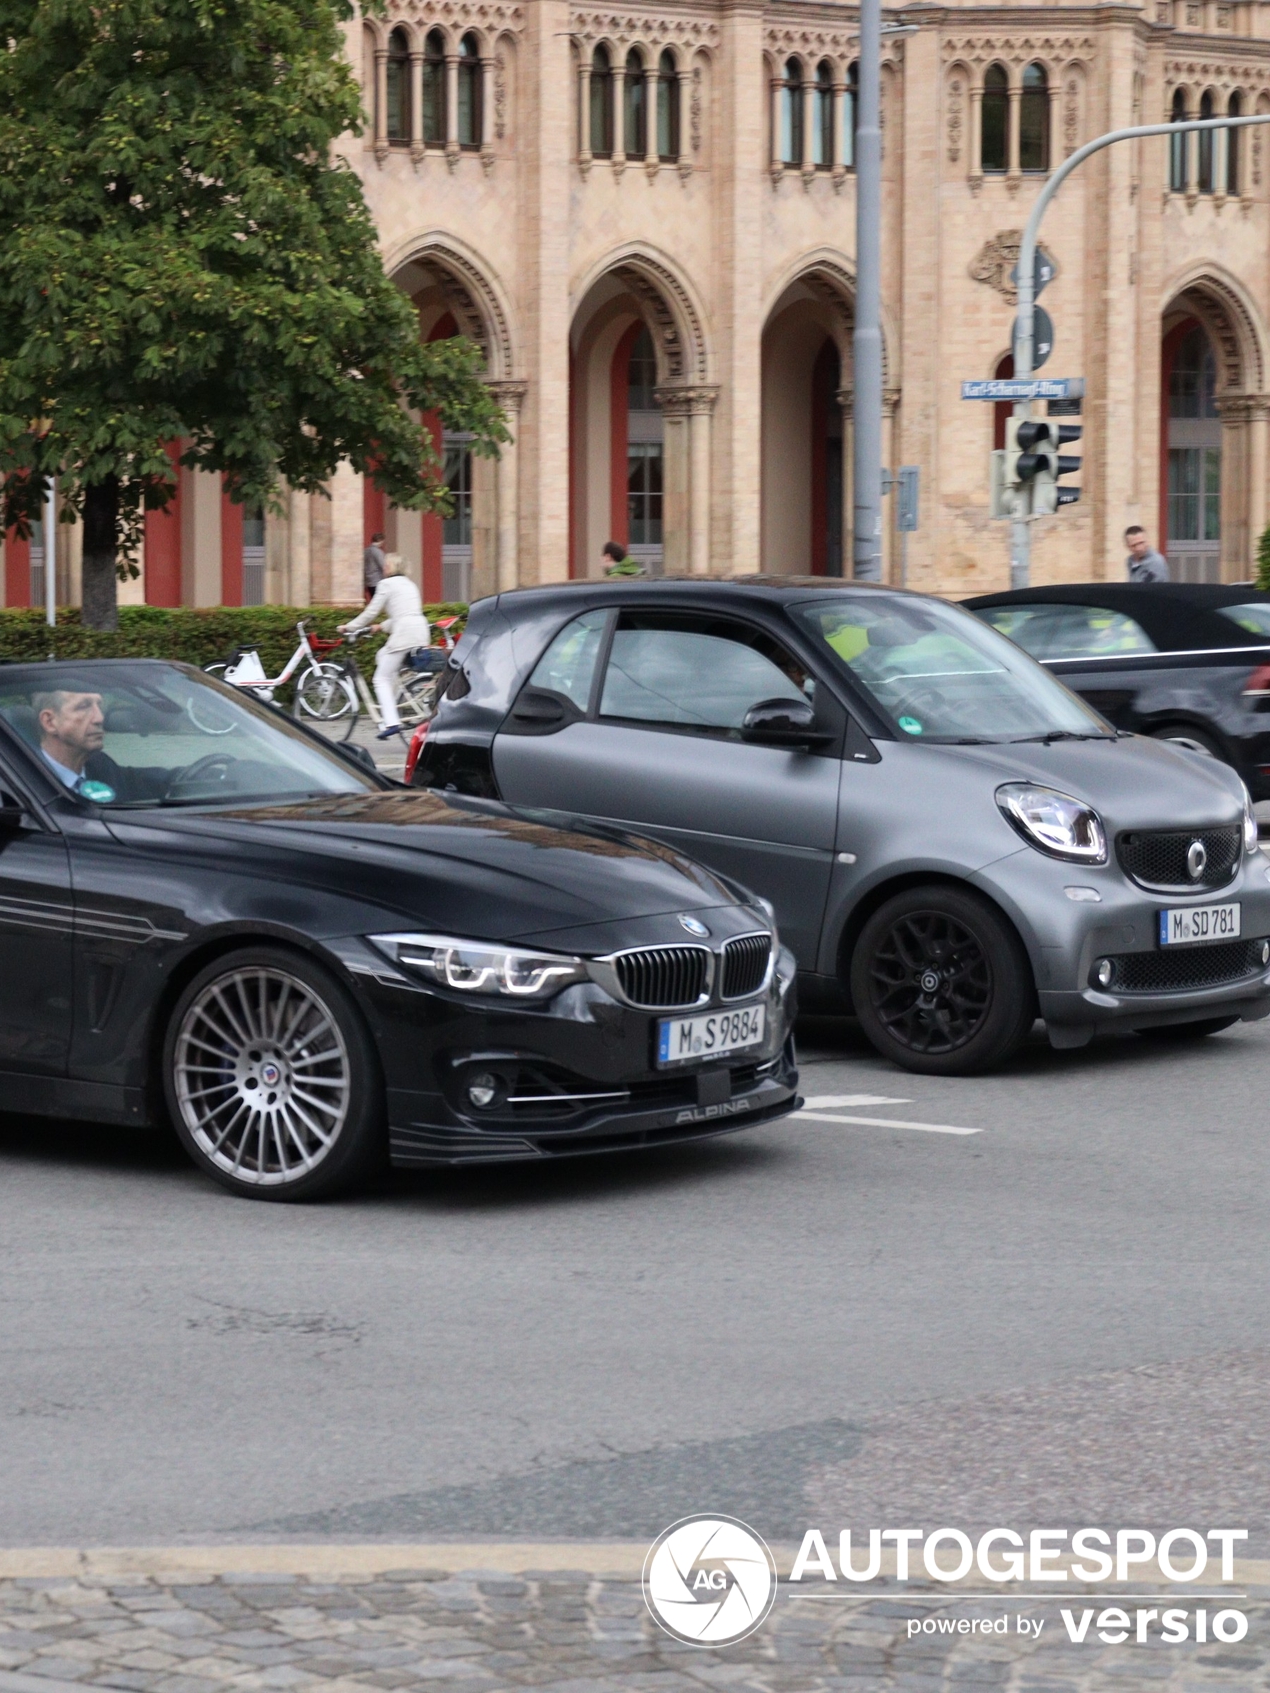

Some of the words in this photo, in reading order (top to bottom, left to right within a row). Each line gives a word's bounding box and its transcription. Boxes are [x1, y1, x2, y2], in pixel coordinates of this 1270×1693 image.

[1174, 913, 1183, 939] M
[1192, 910, 1209, 937] SD
[1212, 908, 1235, 935] 781
[679, 1021, 693, 1054] M
[705, 1018, 716, 1049] S
[720, 1008, 759, 1046] 9884
[675, 1099, 750, 1124] ALPINA
